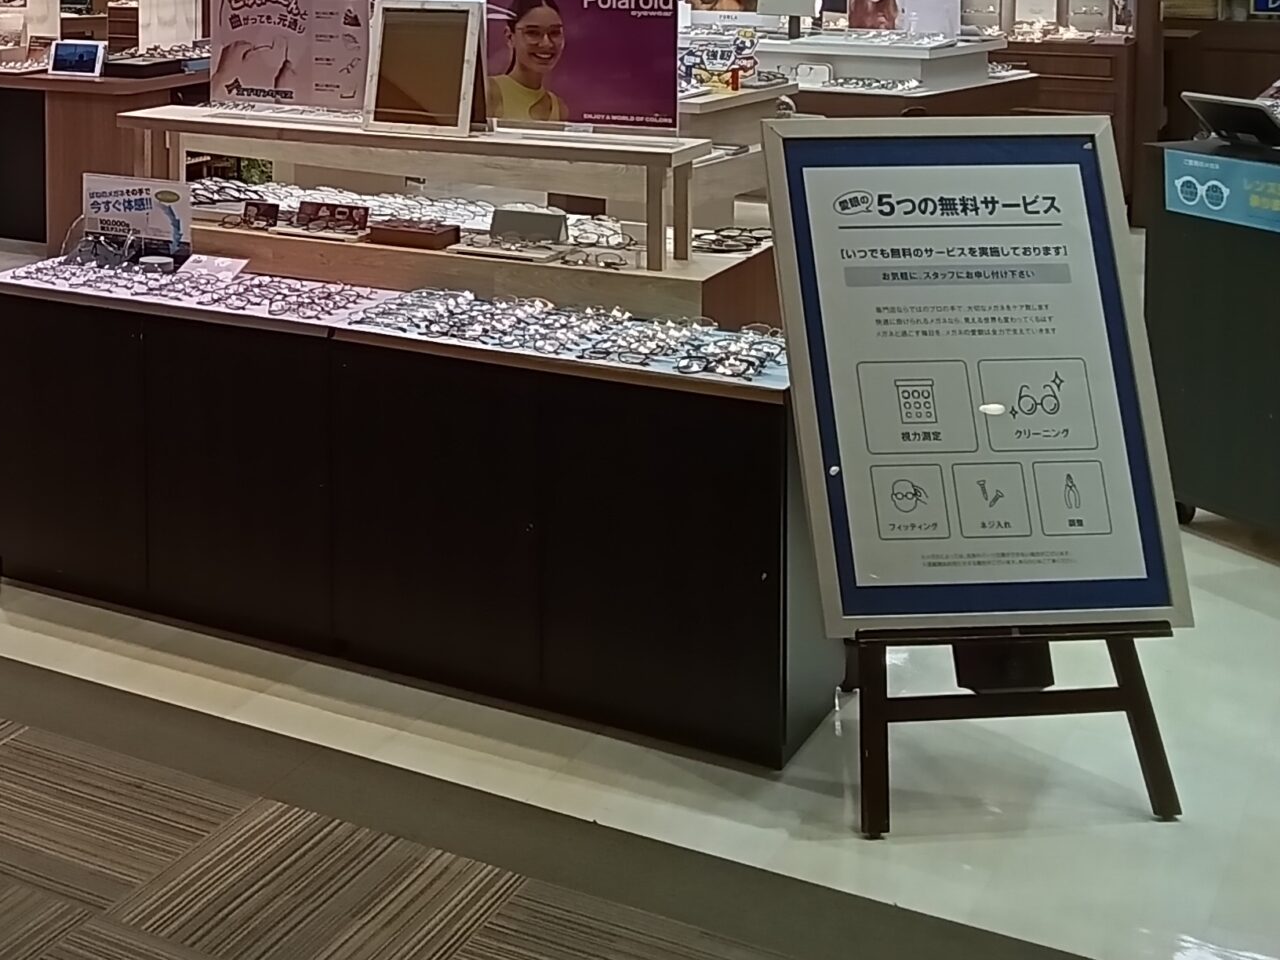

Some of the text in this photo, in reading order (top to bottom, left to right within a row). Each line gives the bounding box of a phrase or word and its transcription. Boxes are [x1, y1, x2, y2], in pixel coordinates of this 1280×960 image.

[630, 10, 673, 18] eyewear
[645, 116, 673, 124] COLORS
[877, 193, 1061, 217] 5つの無料サービス
[901, 431, 943, 442] 視力測定
[1014, 428, 1070, 439] クリーニング
[888, 522, 939, 532] フィッティング
[979, 520, 1012, 530] ネジ入れ
